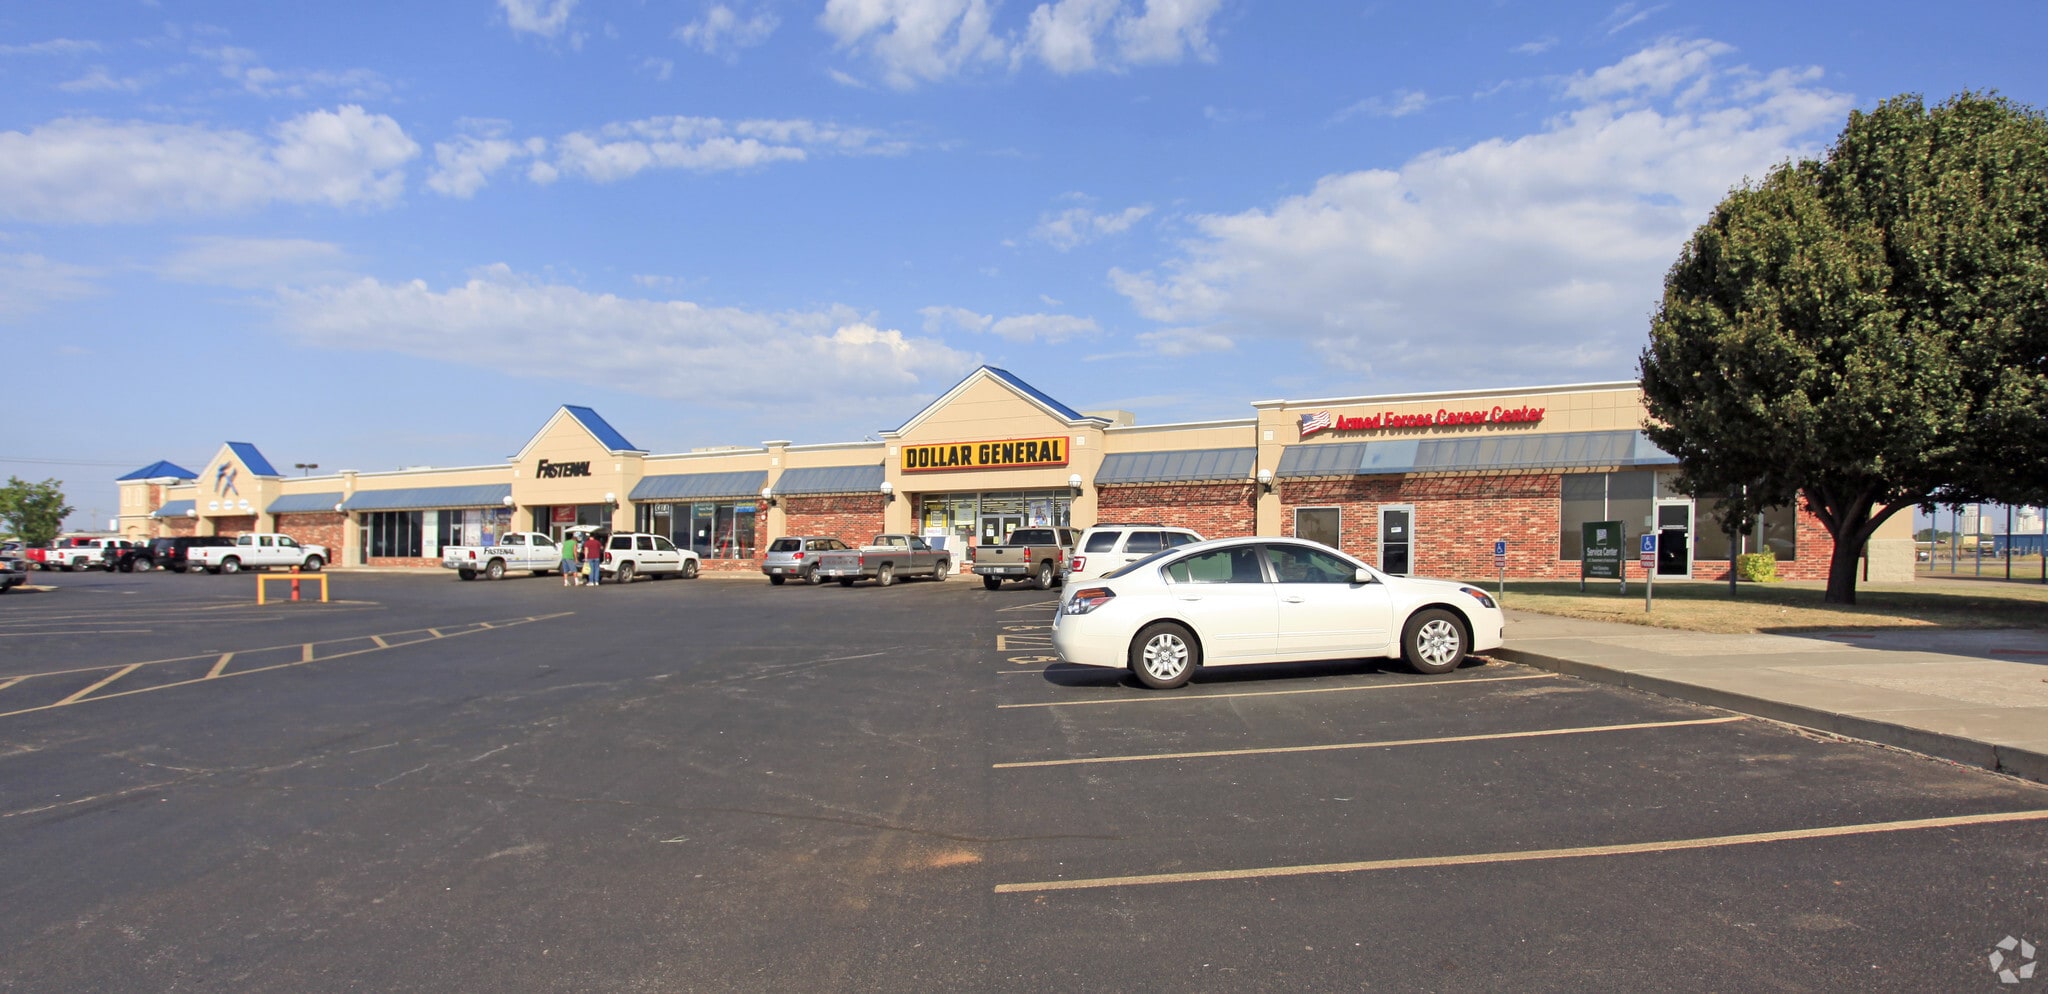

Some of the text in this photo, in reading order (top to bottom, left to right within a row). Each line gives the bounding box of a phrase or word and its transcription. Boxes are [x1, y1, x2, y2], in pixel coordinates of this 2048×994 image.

[1335, 405, 1545, 431] Armed Forces Career Center
[906, 440, 1062, 468] DOLLAR GENERAL
[536, 459, 592, 479] FASTENAL
